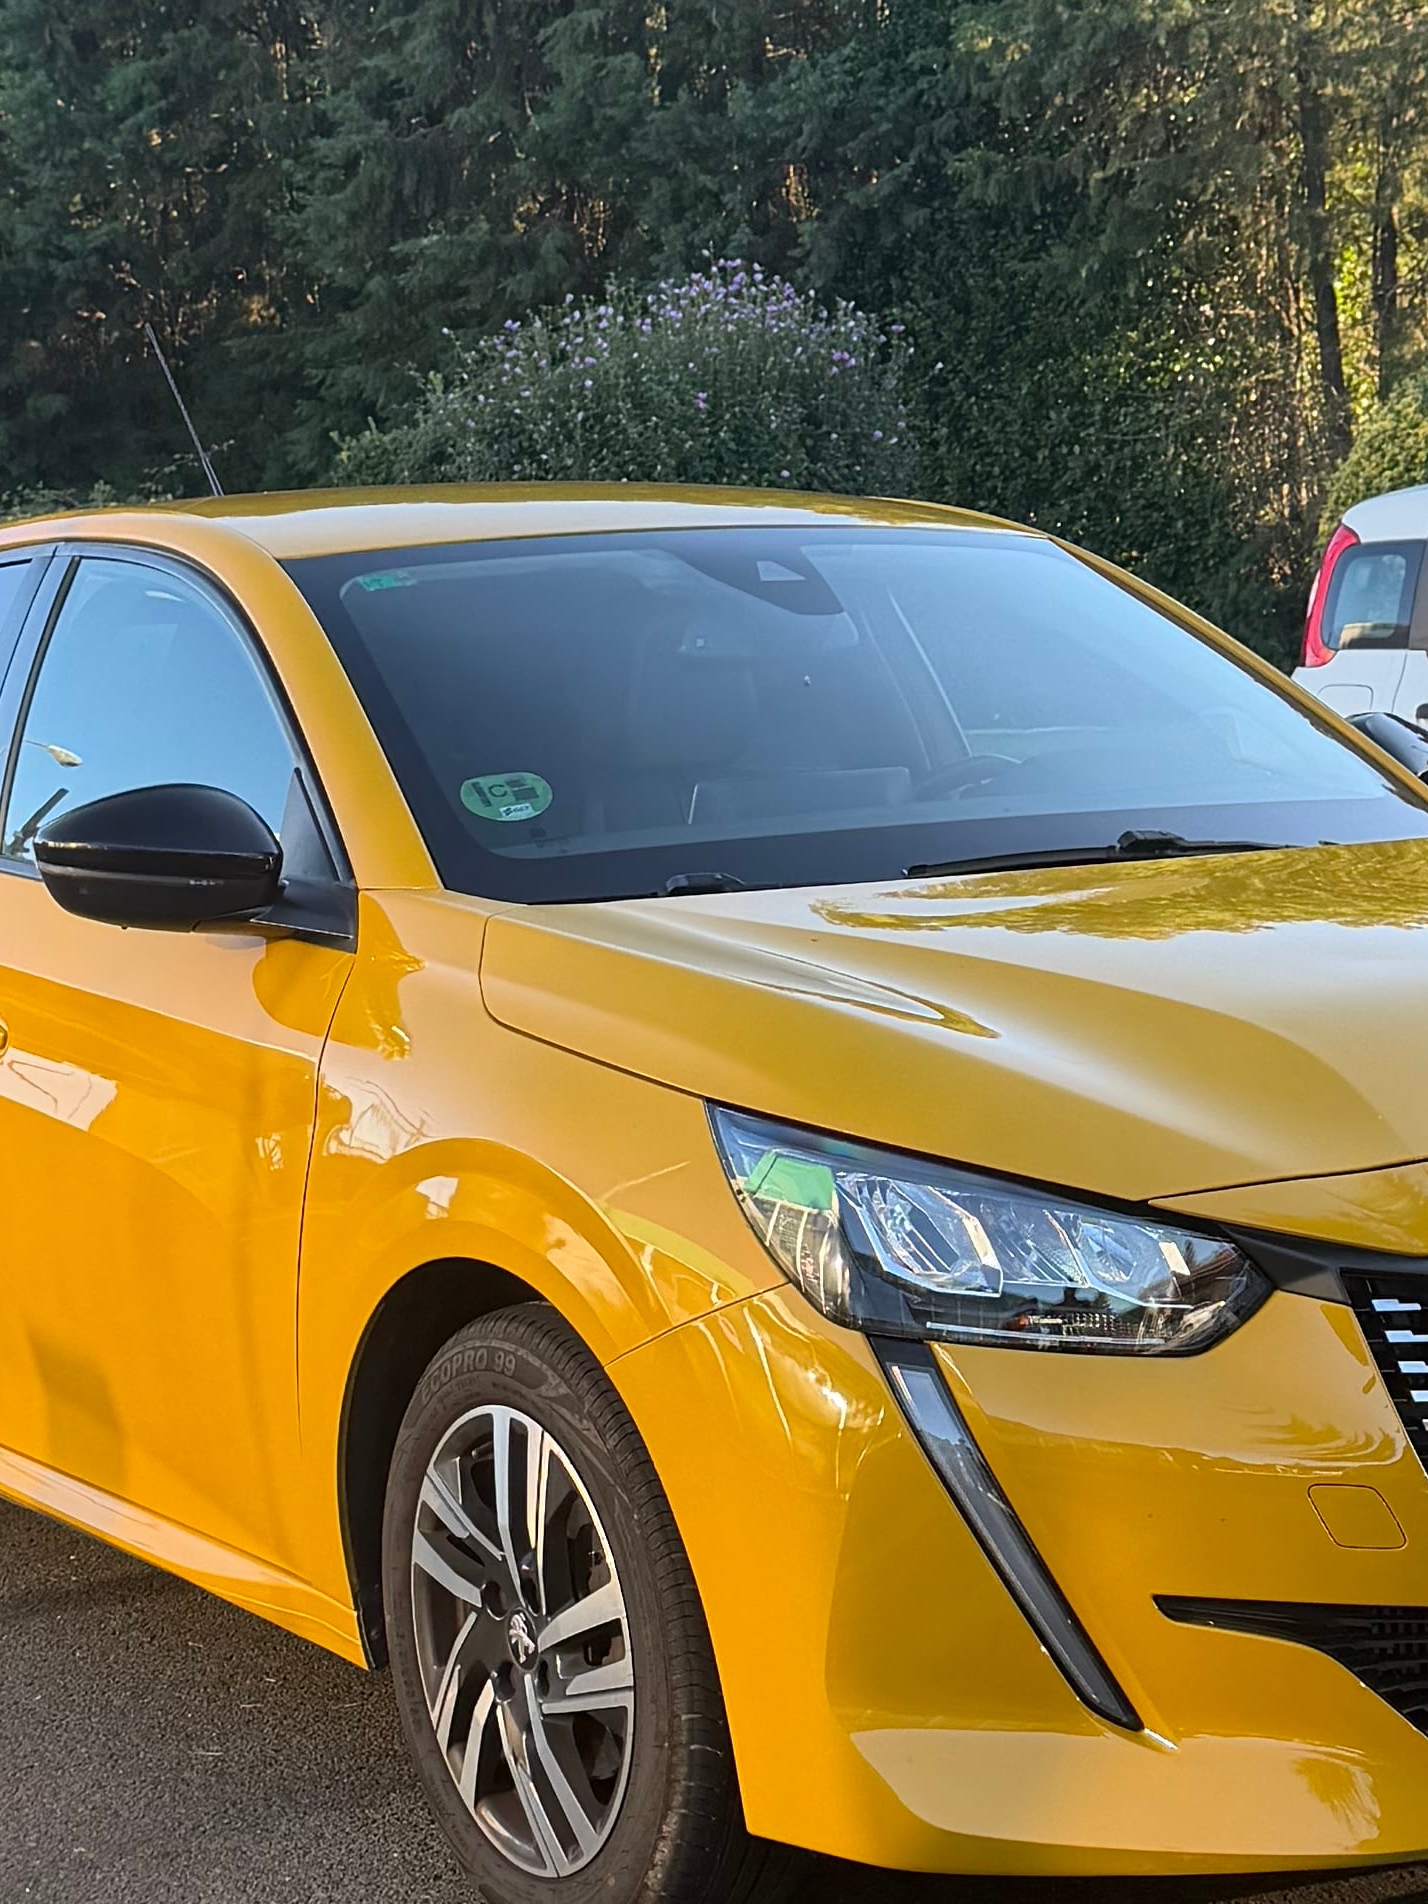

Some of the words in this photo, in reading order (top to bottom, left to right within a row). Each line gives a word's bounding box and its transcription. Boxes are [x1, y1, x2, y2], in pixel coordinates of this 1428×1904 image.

[488, 783, 508, 798] C
[420, 1348, 488, 1404] ECOPRO
[494, 1351, 516, 1377] 99
